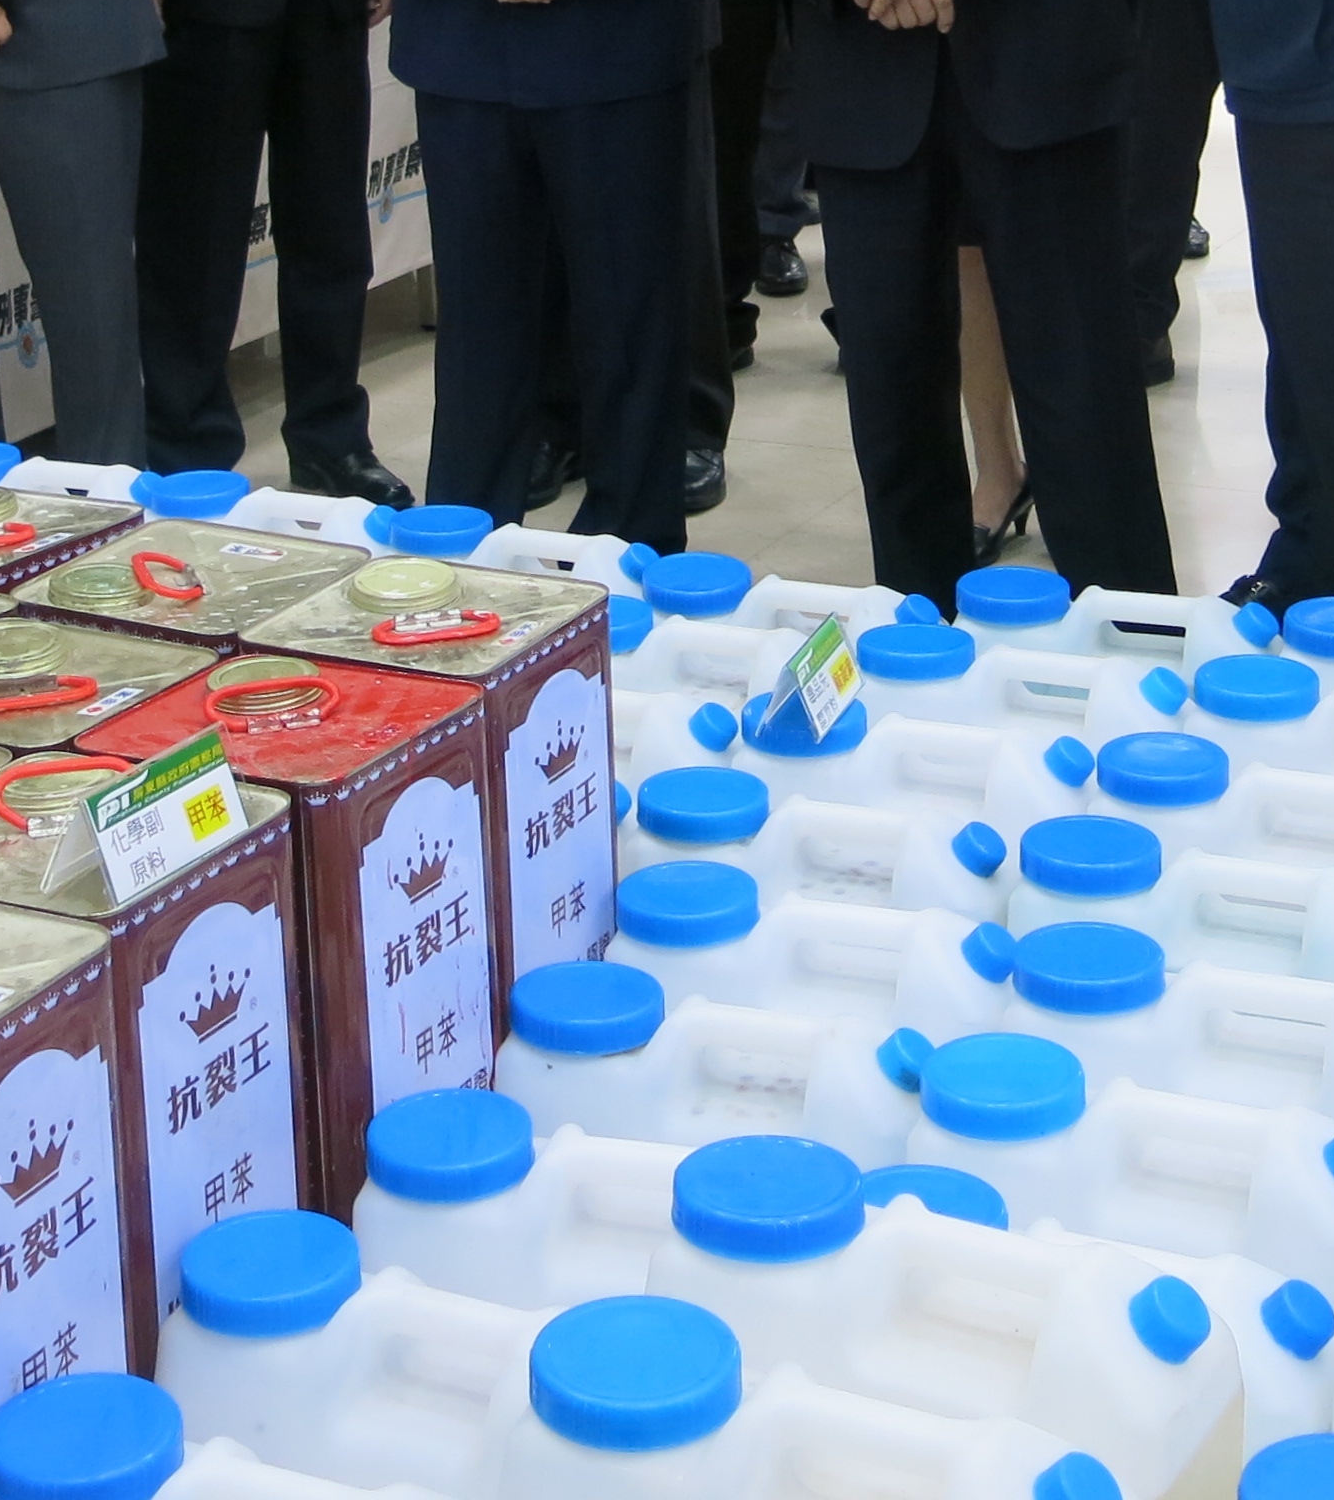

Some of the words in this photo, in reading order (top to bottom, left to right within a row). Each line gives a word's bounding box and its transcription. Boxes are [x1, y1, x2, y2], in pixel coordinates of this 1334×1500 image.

[110, 806, 166, 856] 化學副
[186, 790, 228, 833] 甲苯
[524, 771, 599, 860] 抗裂王
[130, 846, 167, 888] 原料
[382, 889, 471, 989] 抗裂王
[550, 879, 587, 938] 甲苯
[414, 1010, 459, 1075] 甲苯
[167, 1022, 272, 1137] 抗裂王
[204, 1151, 255, 1223] 甲苯
